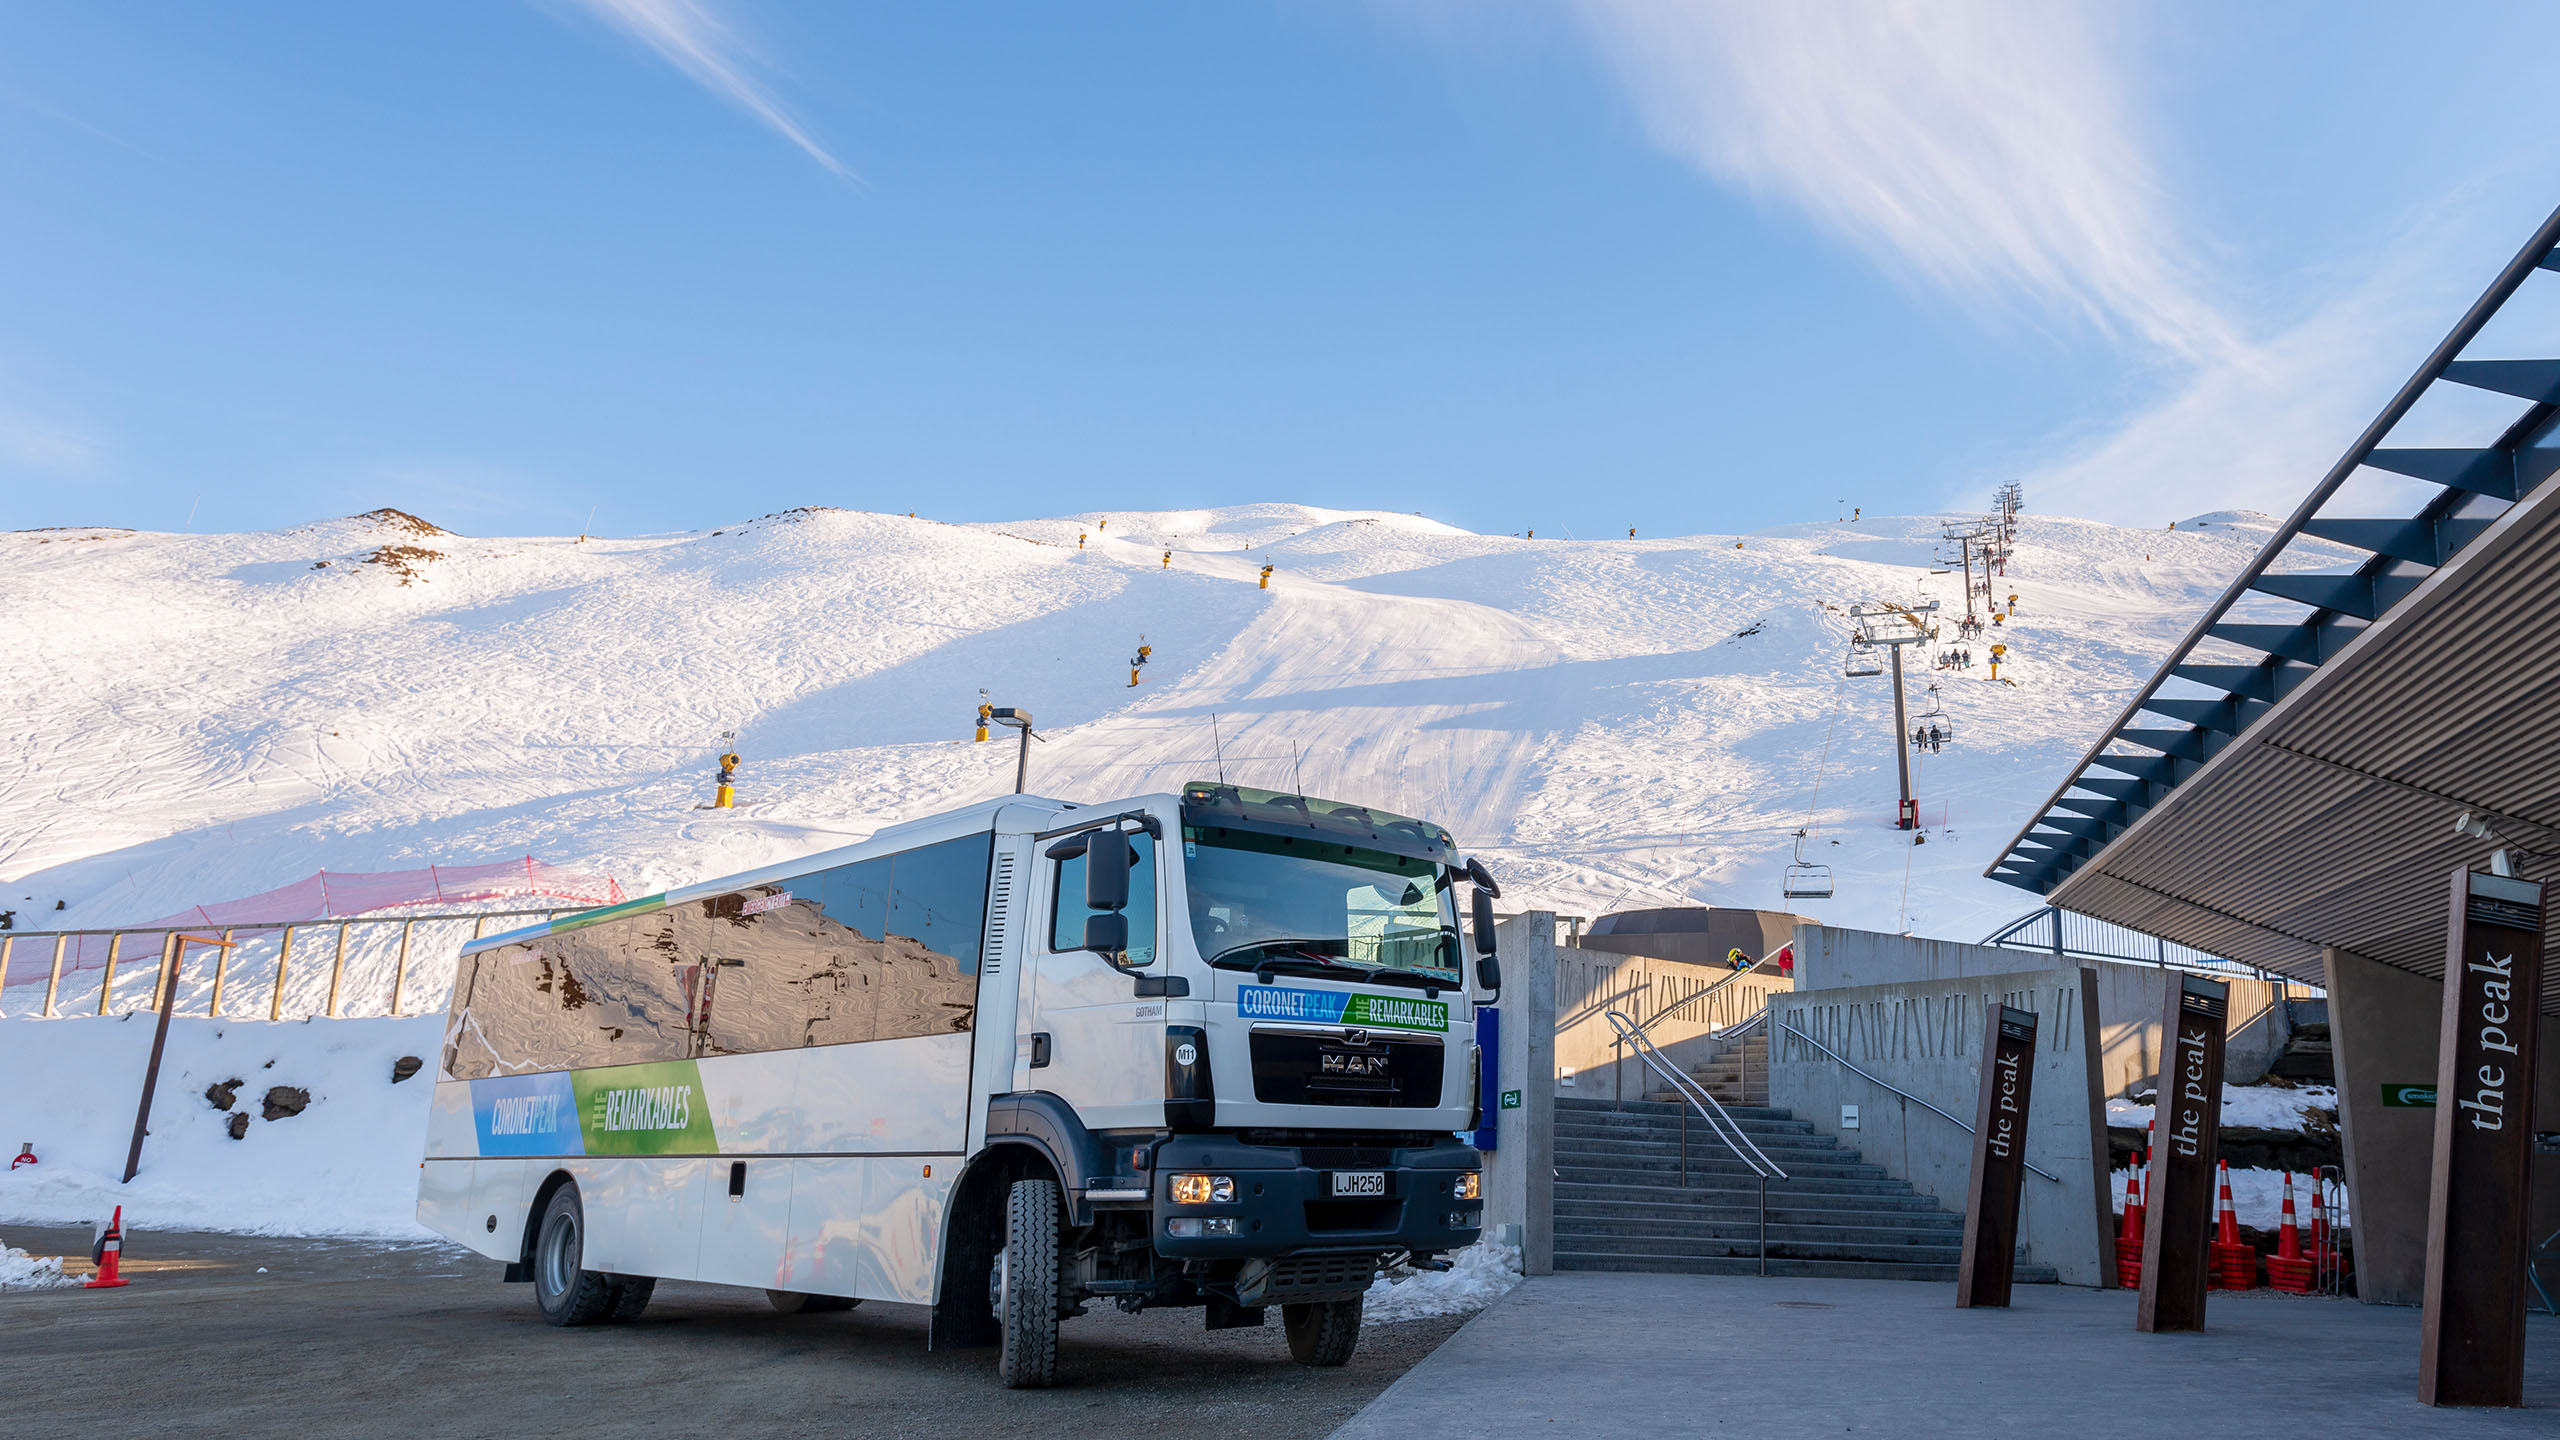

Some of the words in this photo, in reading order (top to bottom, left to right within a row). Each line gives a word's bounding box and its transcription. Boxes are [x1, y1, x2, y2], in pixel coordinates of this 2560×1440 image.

[1136, 1005, 1162, 1018] GOTHAM
[1356, 998, 1370, 1020] THE
[1370, 998, 1444, 1028] REMARKABLES
[2468, 951, 2518, 1056] peak
[1178, 1049, 1195, 1060] M11
[1322, 1055, 1388, 1076] MAN
[2179, 1029, 2207, 1103] peak
[1997, 1052, 2019, 1113] peak
[2459, 1064, 2505, 1131] the
[591, 1090, 608, 1131] THE
[604, 1085, 691, 1132] REMARKABLES
[1989, 1118, 2012, 1157] the
[2171, 1108, 2199, 1156] the
[1336, 1175, 1383, 1193] LJH250
